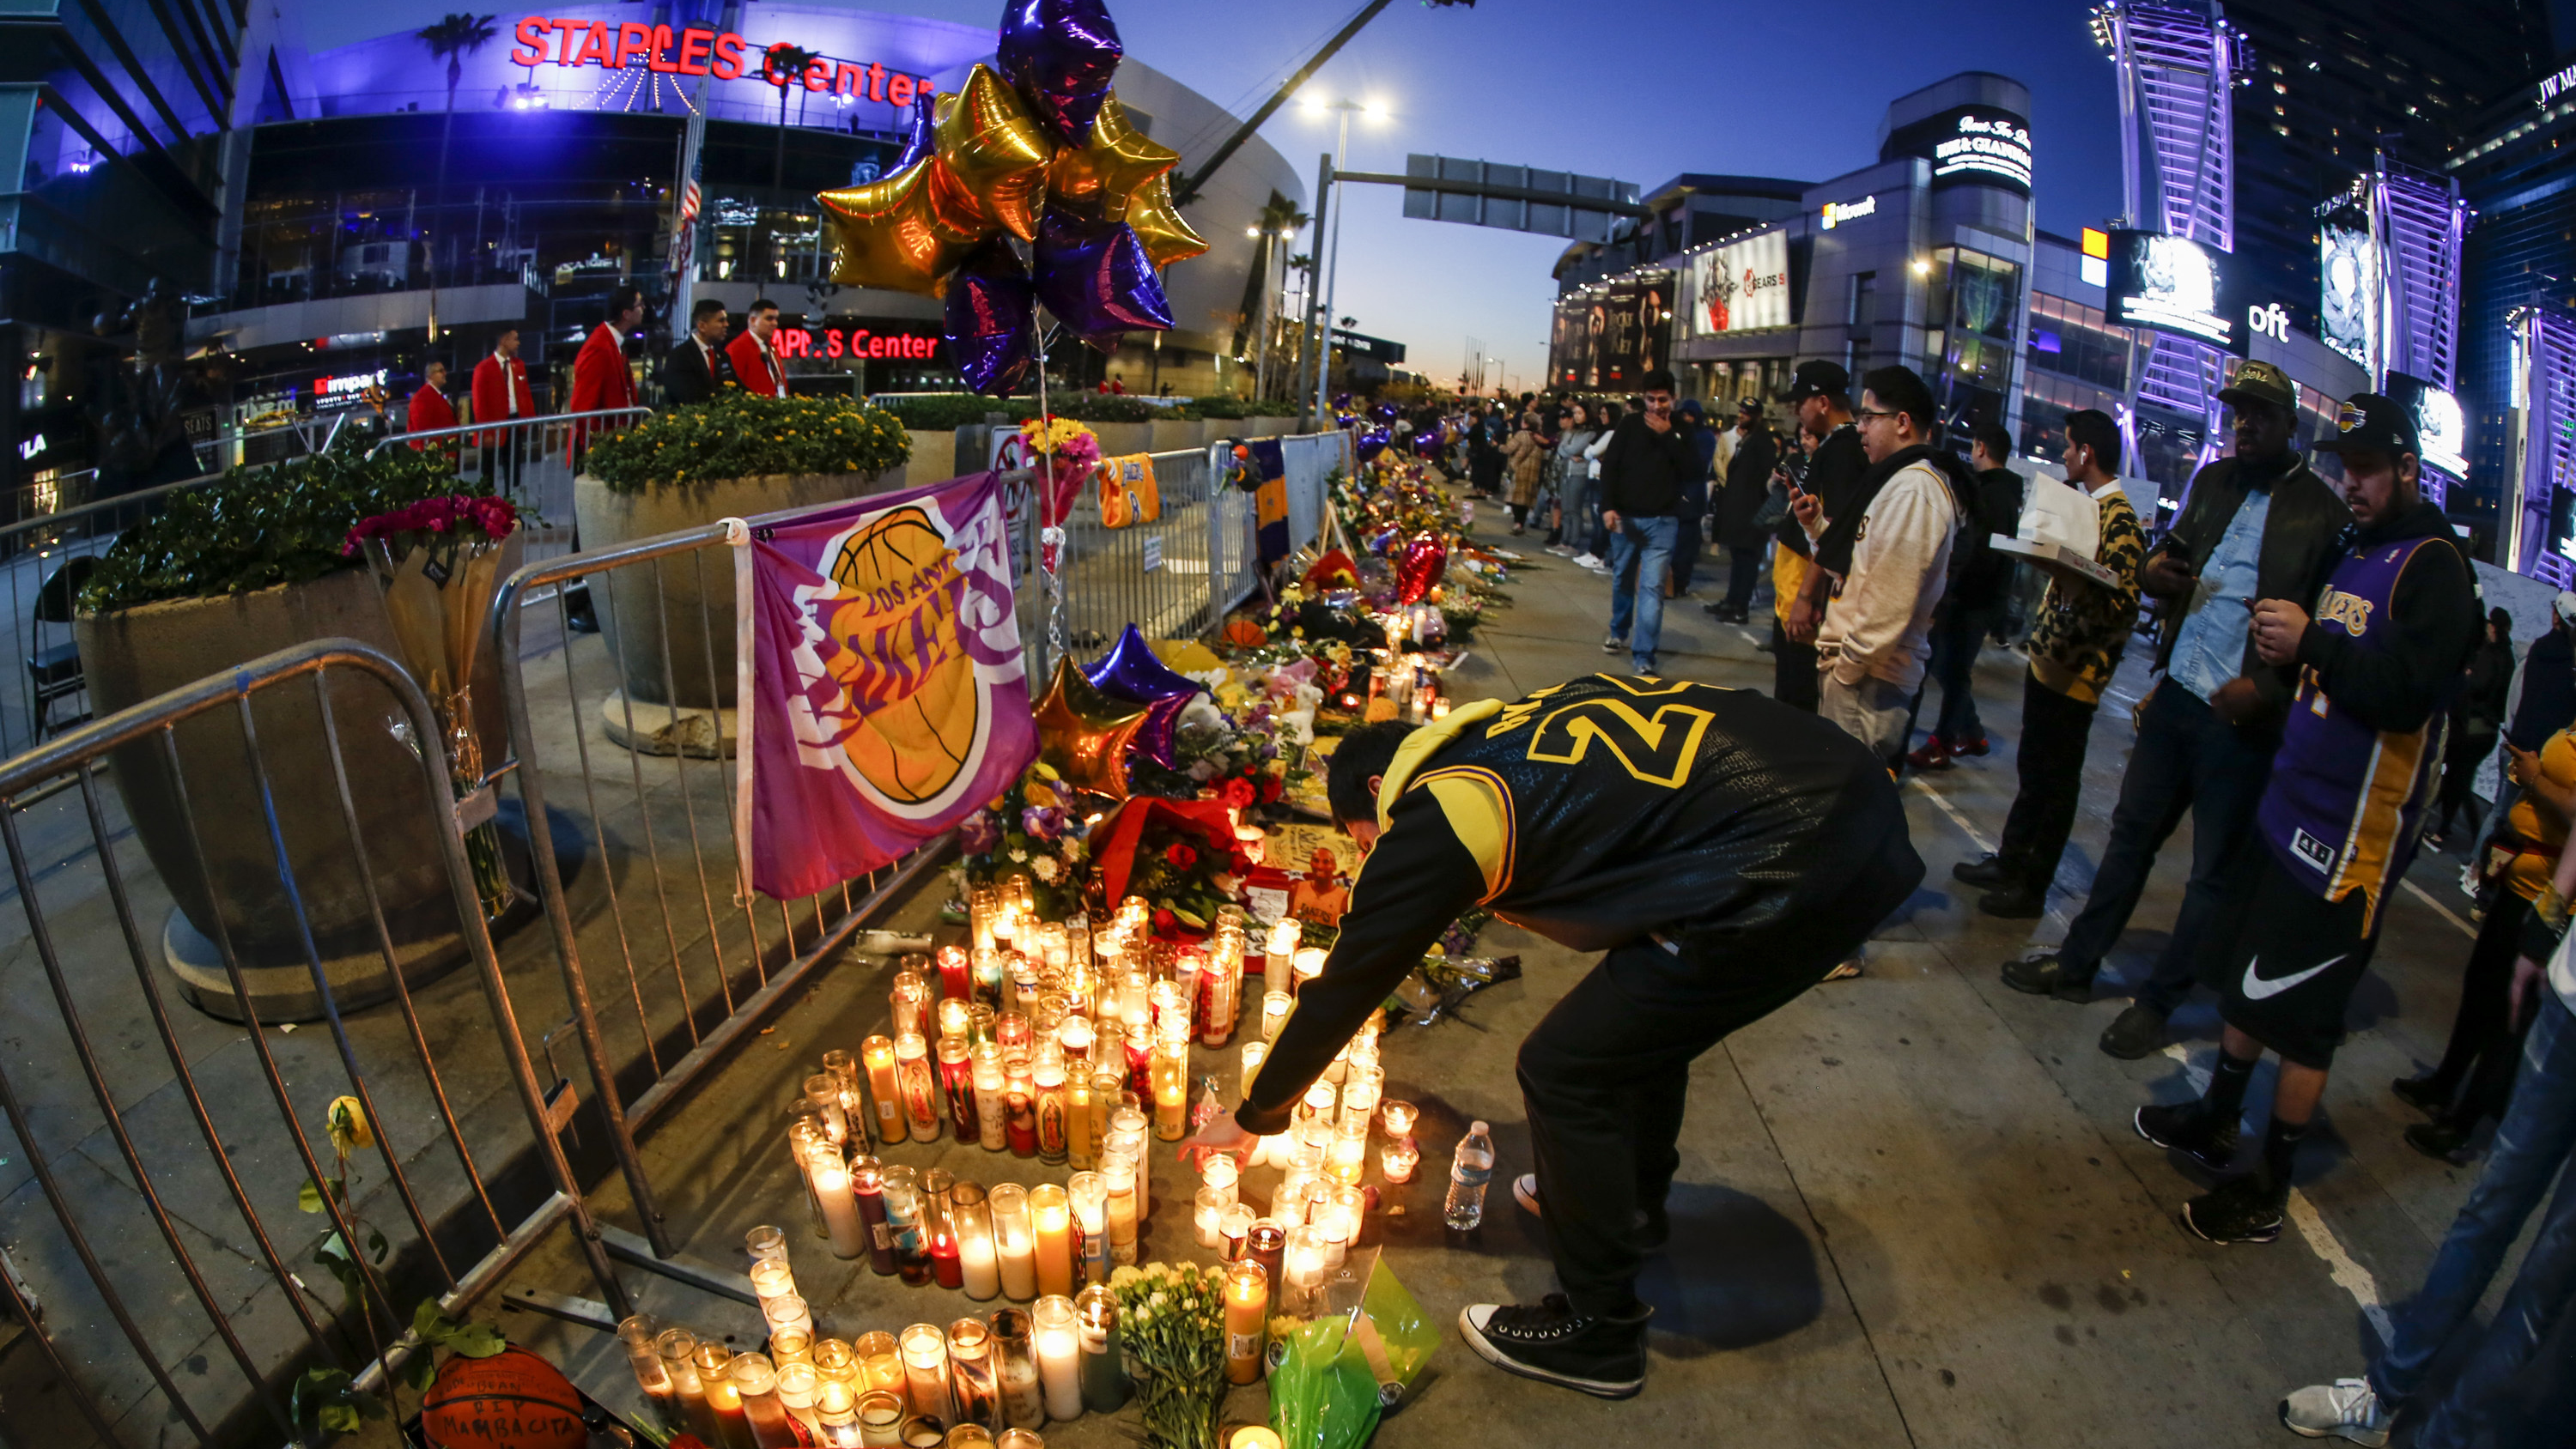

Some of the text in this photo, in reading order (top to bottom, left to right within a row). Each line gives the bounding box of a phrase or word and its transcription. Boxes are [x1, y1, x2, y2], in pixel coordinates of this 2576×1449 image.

[512, 15, 747, 81] STAPLES
[2538, 64, 2576, 105] JW M
[1752, 275, 1777, 290] GEARS
[2248, 302, 2290, 343] oft
[852, 330, 939, 359] Center
[327, 368, 388, 394] impat
[861, 579, 906, 619] LOS
